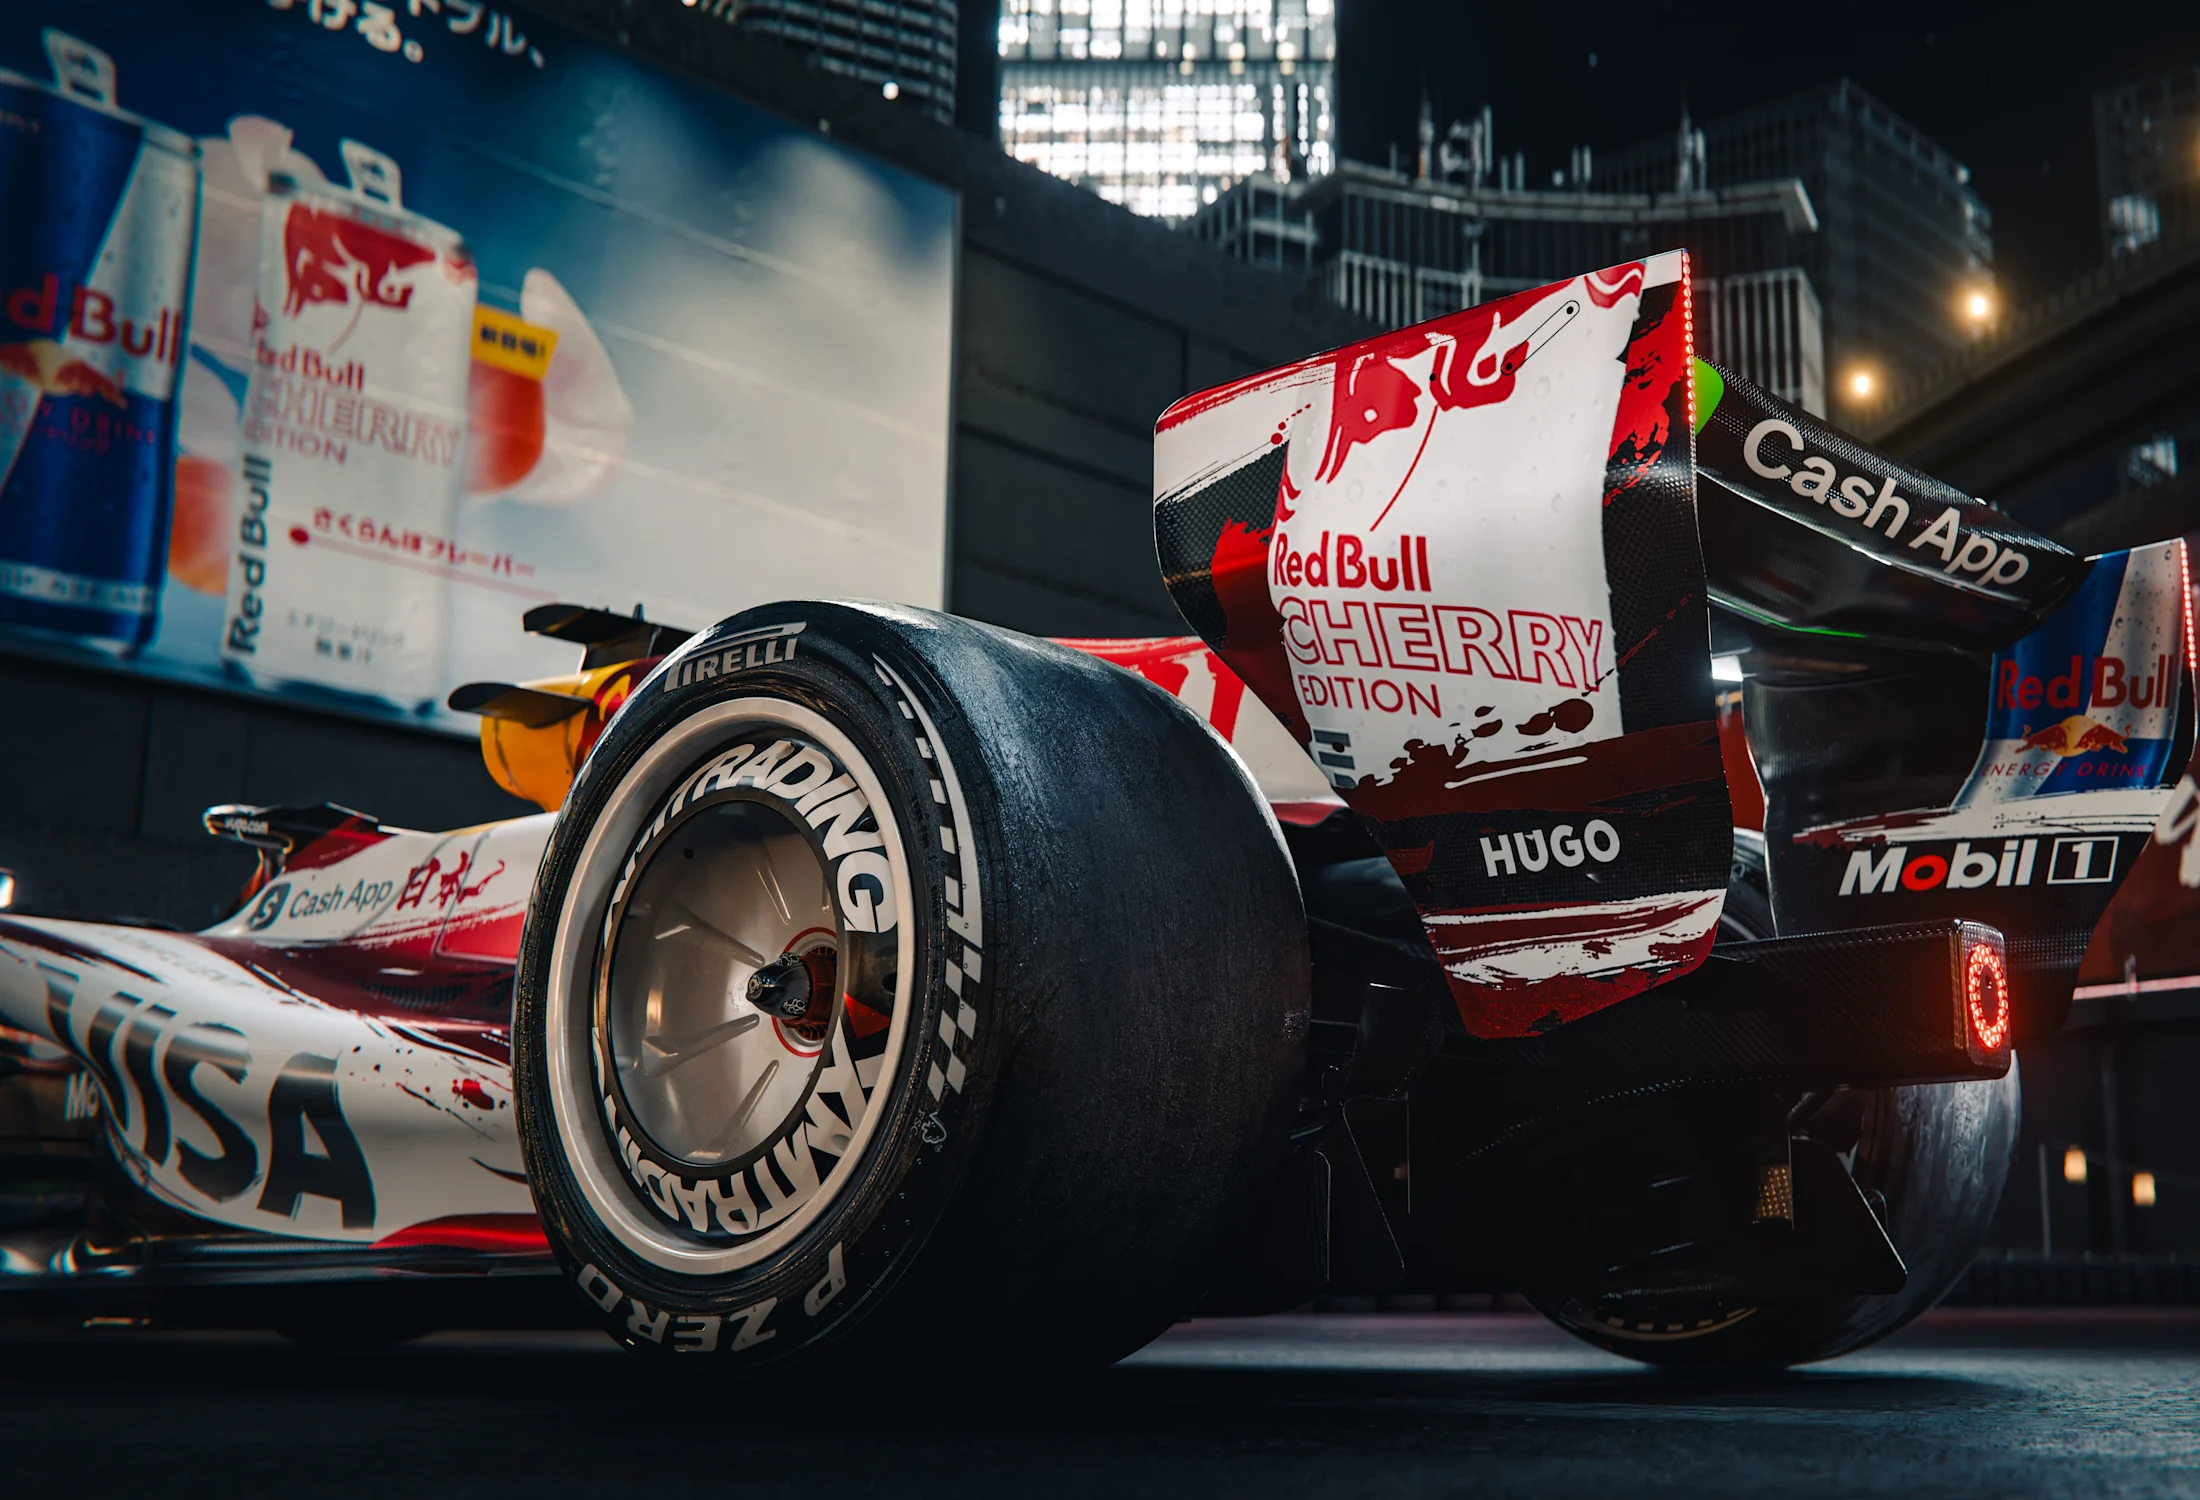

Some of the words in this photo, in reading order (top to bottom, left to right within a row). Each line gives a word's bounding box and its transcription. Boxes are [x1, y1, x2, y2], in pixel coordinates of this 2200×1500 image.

[68, 283, 183, 368] Bull
[302, 346, 365, 393] Bull
[240, 452, 273, 548] Bull
[1743, 418, 1910, 540] Cash
[1909, 507, 2030, 587] App
[1273, 530, 1330, 588] Red
[1336, 534, 1432, 592] Bull
[228, 552, 266, 659] Red
[664, 620, 808, 694] PIRELLI
[1281, 596, 1603, 692] CHERRY
[1299, 674, 1442, 718] EDITION
[1997, 654, 2081, 711] Red
[2090, 653, 2173, 709] Bull
[1982, 762, 2068, 777] ENERGY
[2077, 762, 2148, 778] DRINK
[1479, 818, 1621, 878] HUGO
[1838, 838, 2038, 896] Mobil
[289, 884, 344, 919] Cash
[345, 878, 393, 914] App
[36, 962, 377, 1232] VISA
[576, 1262, 778, 1352] ZERO
[804, 1240, 846, 1316] P
